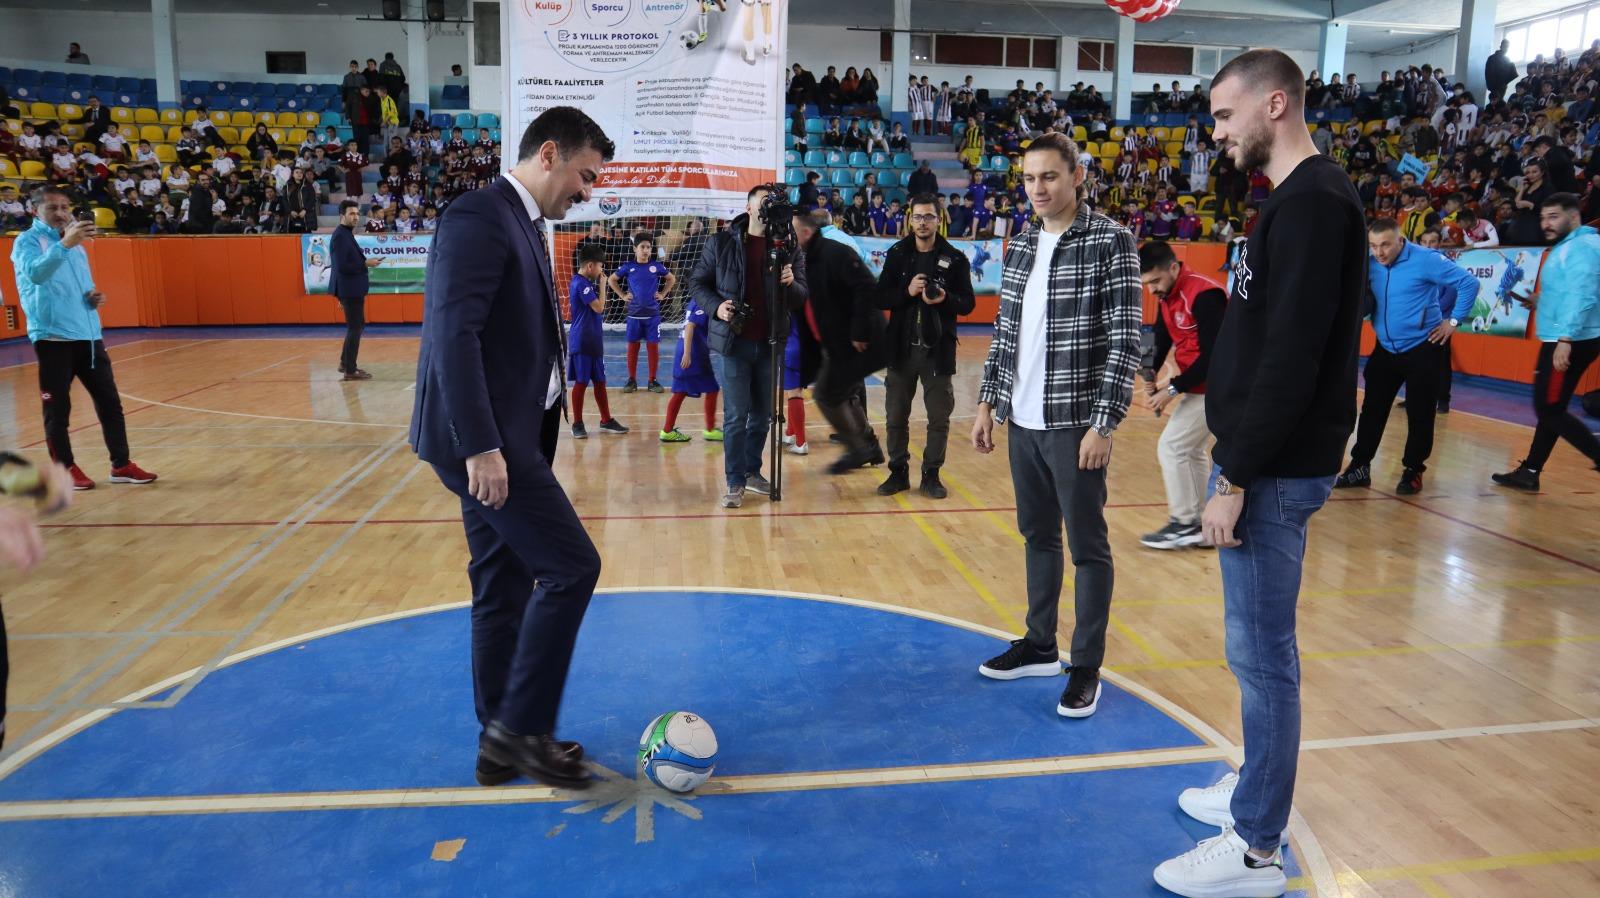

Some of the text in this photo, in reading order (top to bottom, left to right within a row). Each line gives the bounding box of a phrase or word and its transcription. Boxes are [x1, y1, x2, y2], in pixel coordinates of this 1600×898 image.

[535, 2, 562, 12] Kulüp
[591, 3, 623, 13] Sporcu
[645, 3, 684, 11] Antrenör
[554, 78, 604, 86] FAALİYETLER
[661, 164, 678, 173] TÜM
[678, 166, 738, 177] SPORCULARIMIZA
[372, 247, 404, 255] OLSUN
